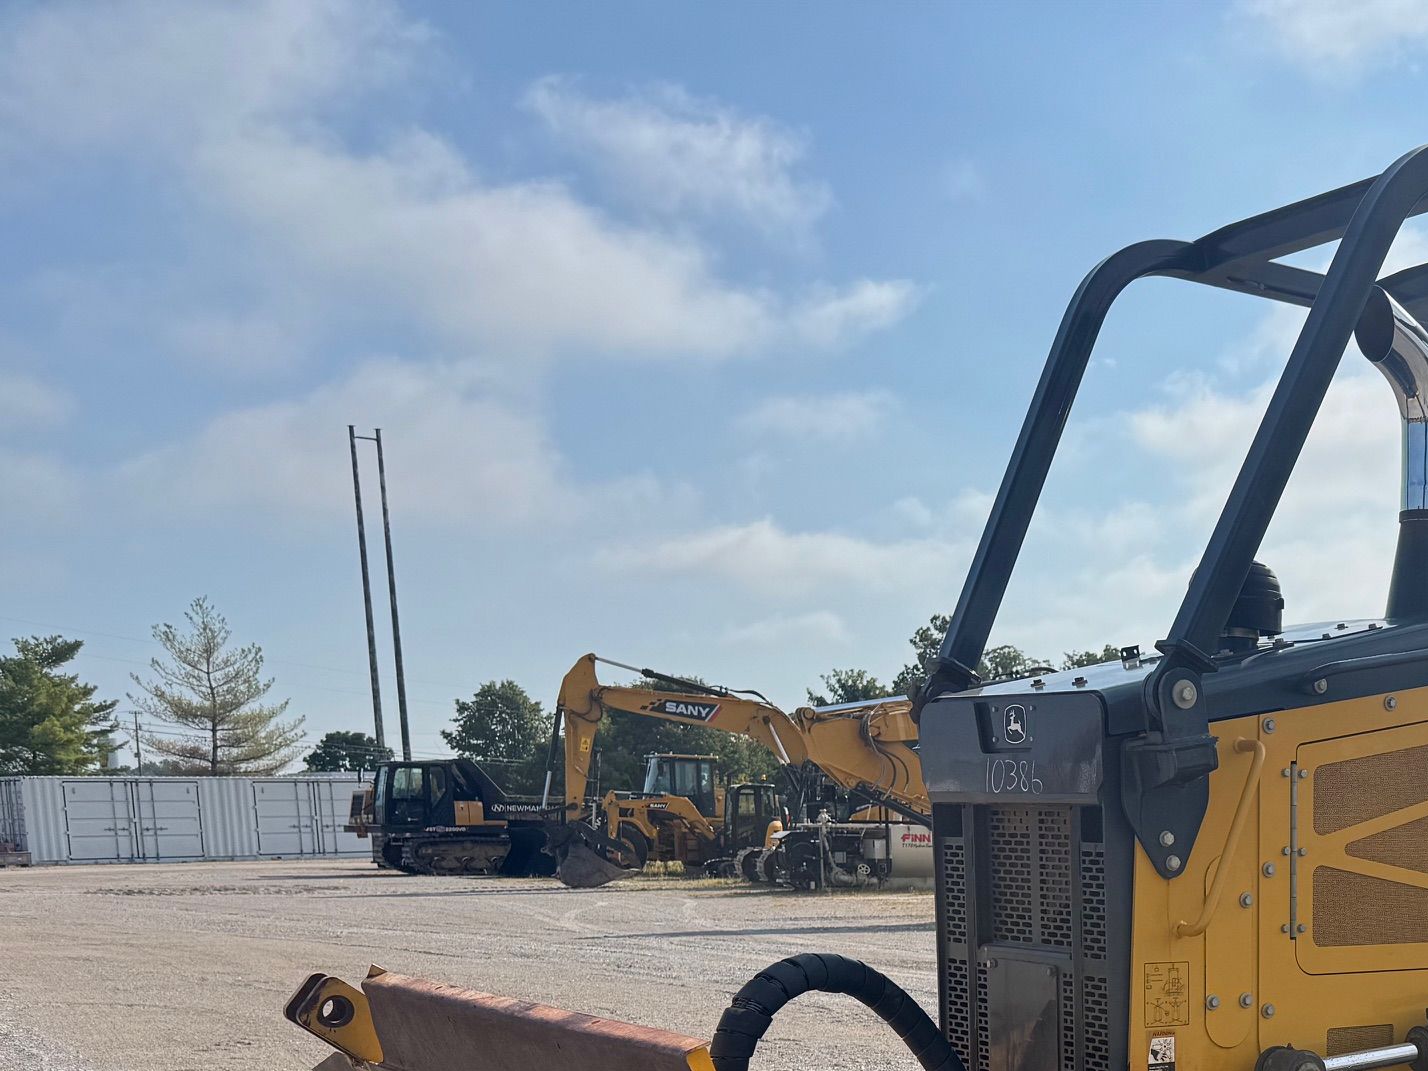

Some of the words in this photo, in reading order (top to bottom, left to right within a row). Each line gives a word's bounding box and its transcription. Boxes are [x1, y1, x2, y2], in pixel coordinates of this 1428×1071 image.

[665, 701, 710, 718] SANY
[985, 757, 1043, 795] 10386
[901, 833, 931, 843] FINN
